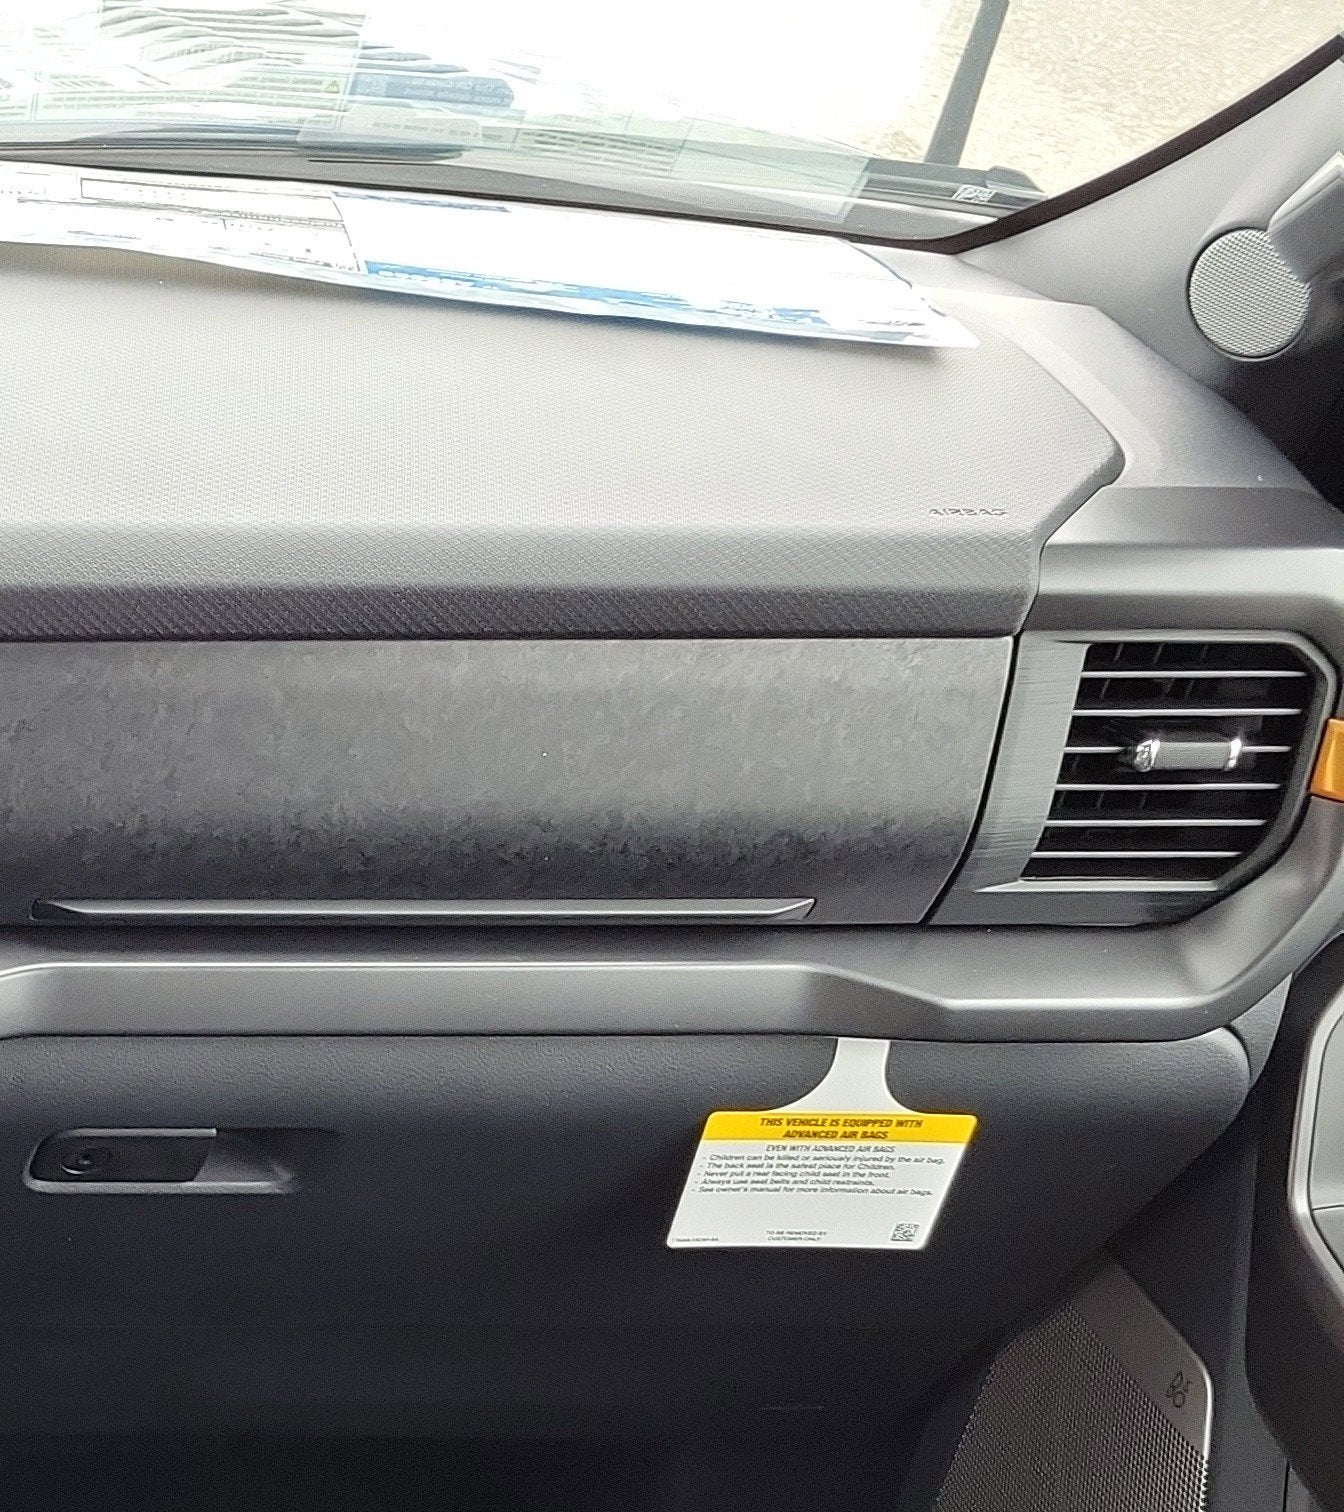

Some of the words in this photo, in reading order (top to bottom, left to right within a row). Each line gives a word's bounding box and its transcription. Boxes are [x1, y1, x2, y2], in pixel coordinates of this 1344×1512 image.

[760, 1117, 783, 1126] THIS
[786, 1117, 826, 1127] VEHICLE
[829, 1118, 839, 1127] IS
[842, 1119, 893, 1127] EQUIPPED
[895, 1119, 924, 1128] WITH
[783, 1129, 838, 1139] ADVANCED
[839, 1130, 859, 1139] AIR
[861, 1130, 889, 1139] BAGS
[766, 1144, 787, 1152] EVEN
[789, 1144, 811, 1152] WITH
[813, 1144, 856, 1152] ADVANCED
[873, 1145, 895, 1153] BAGS
[776, 1154, 799, 1162] killed
[707, 1162, 723, 1170] The
[724, 1162, 744, 1170] back
[820, 1187, 868, 1195] information
